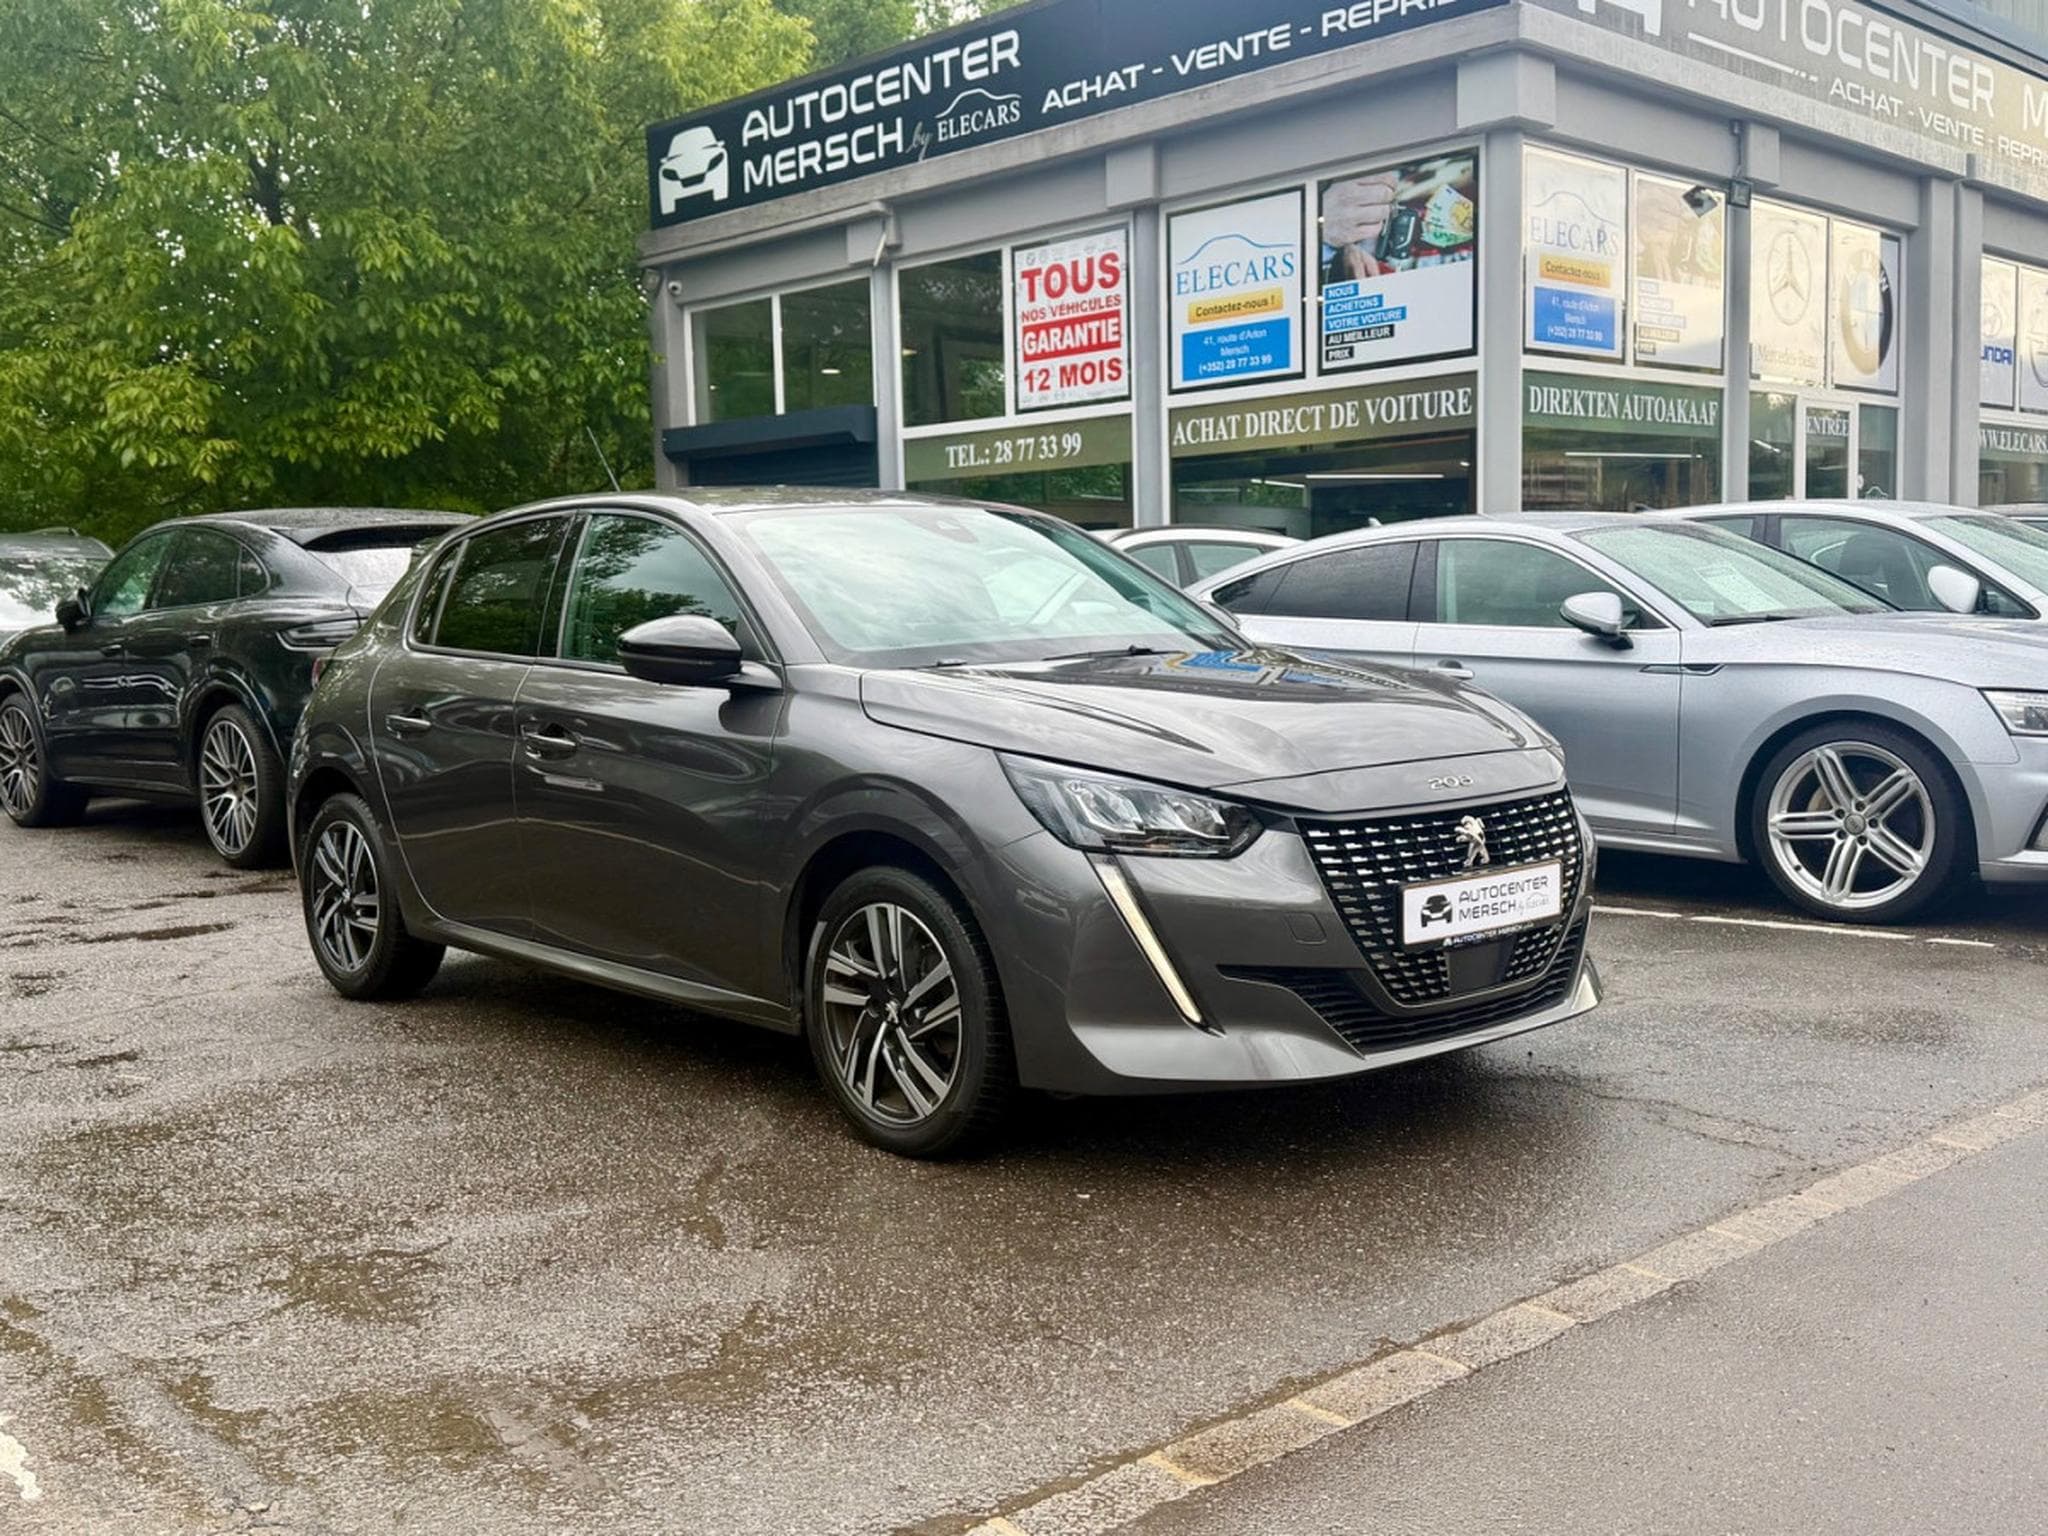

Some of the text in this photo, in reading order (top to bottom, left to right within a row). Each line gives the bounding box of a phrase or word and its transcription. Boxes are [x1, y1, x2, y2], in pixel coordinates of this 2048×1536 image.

[1040, 63, 1145, 114] ACHAT
[1170, 22, 1292, 77] VENTE
[742, 29, 1021, 147] AUTOCENTER
[1829, 76, 1904, 118] ACHAT
[1918, 106, 1985, 147] VENTE
[743, 100, 1021, 194] MERSCH by ELECARS
[1530, 215, 1619, 257] ELECARS
[1021, 252, 1121, 303] TOUS
[1176, 251, 1296, 297] ELECARS
[1328, 285, 1354, 298] NOUS
[1021, 308, 1046, 323] NOS
[1196, 297, 1268, 317] Contactez-nous
[1328, 297, 1380, 314] ACHETONS
[1328, 308, 1402, 329] VOTRE VOITURE
[1023, 317, 1120, 356] GARANTIE
[1328, 327, 1391, 345] AU MEILLEUR
[1023, 357, 1123, 393] 12 MOIS
[1238, 357, 1248, 367] 77
[1173, 387, 1474, 446] ACHAT DIRECT DE VOITURE
[1528, 385, 1719, 427] DIREKTEN AUTOAKAAF
[945, 432, 1082, 468] TEL.: 28 77 33 99
[1428, 774, 1474, 790] 208
[1459, 875, 1549, 903] AUTOCENTER
[1459, 899, 1517, 922] MERSCH
